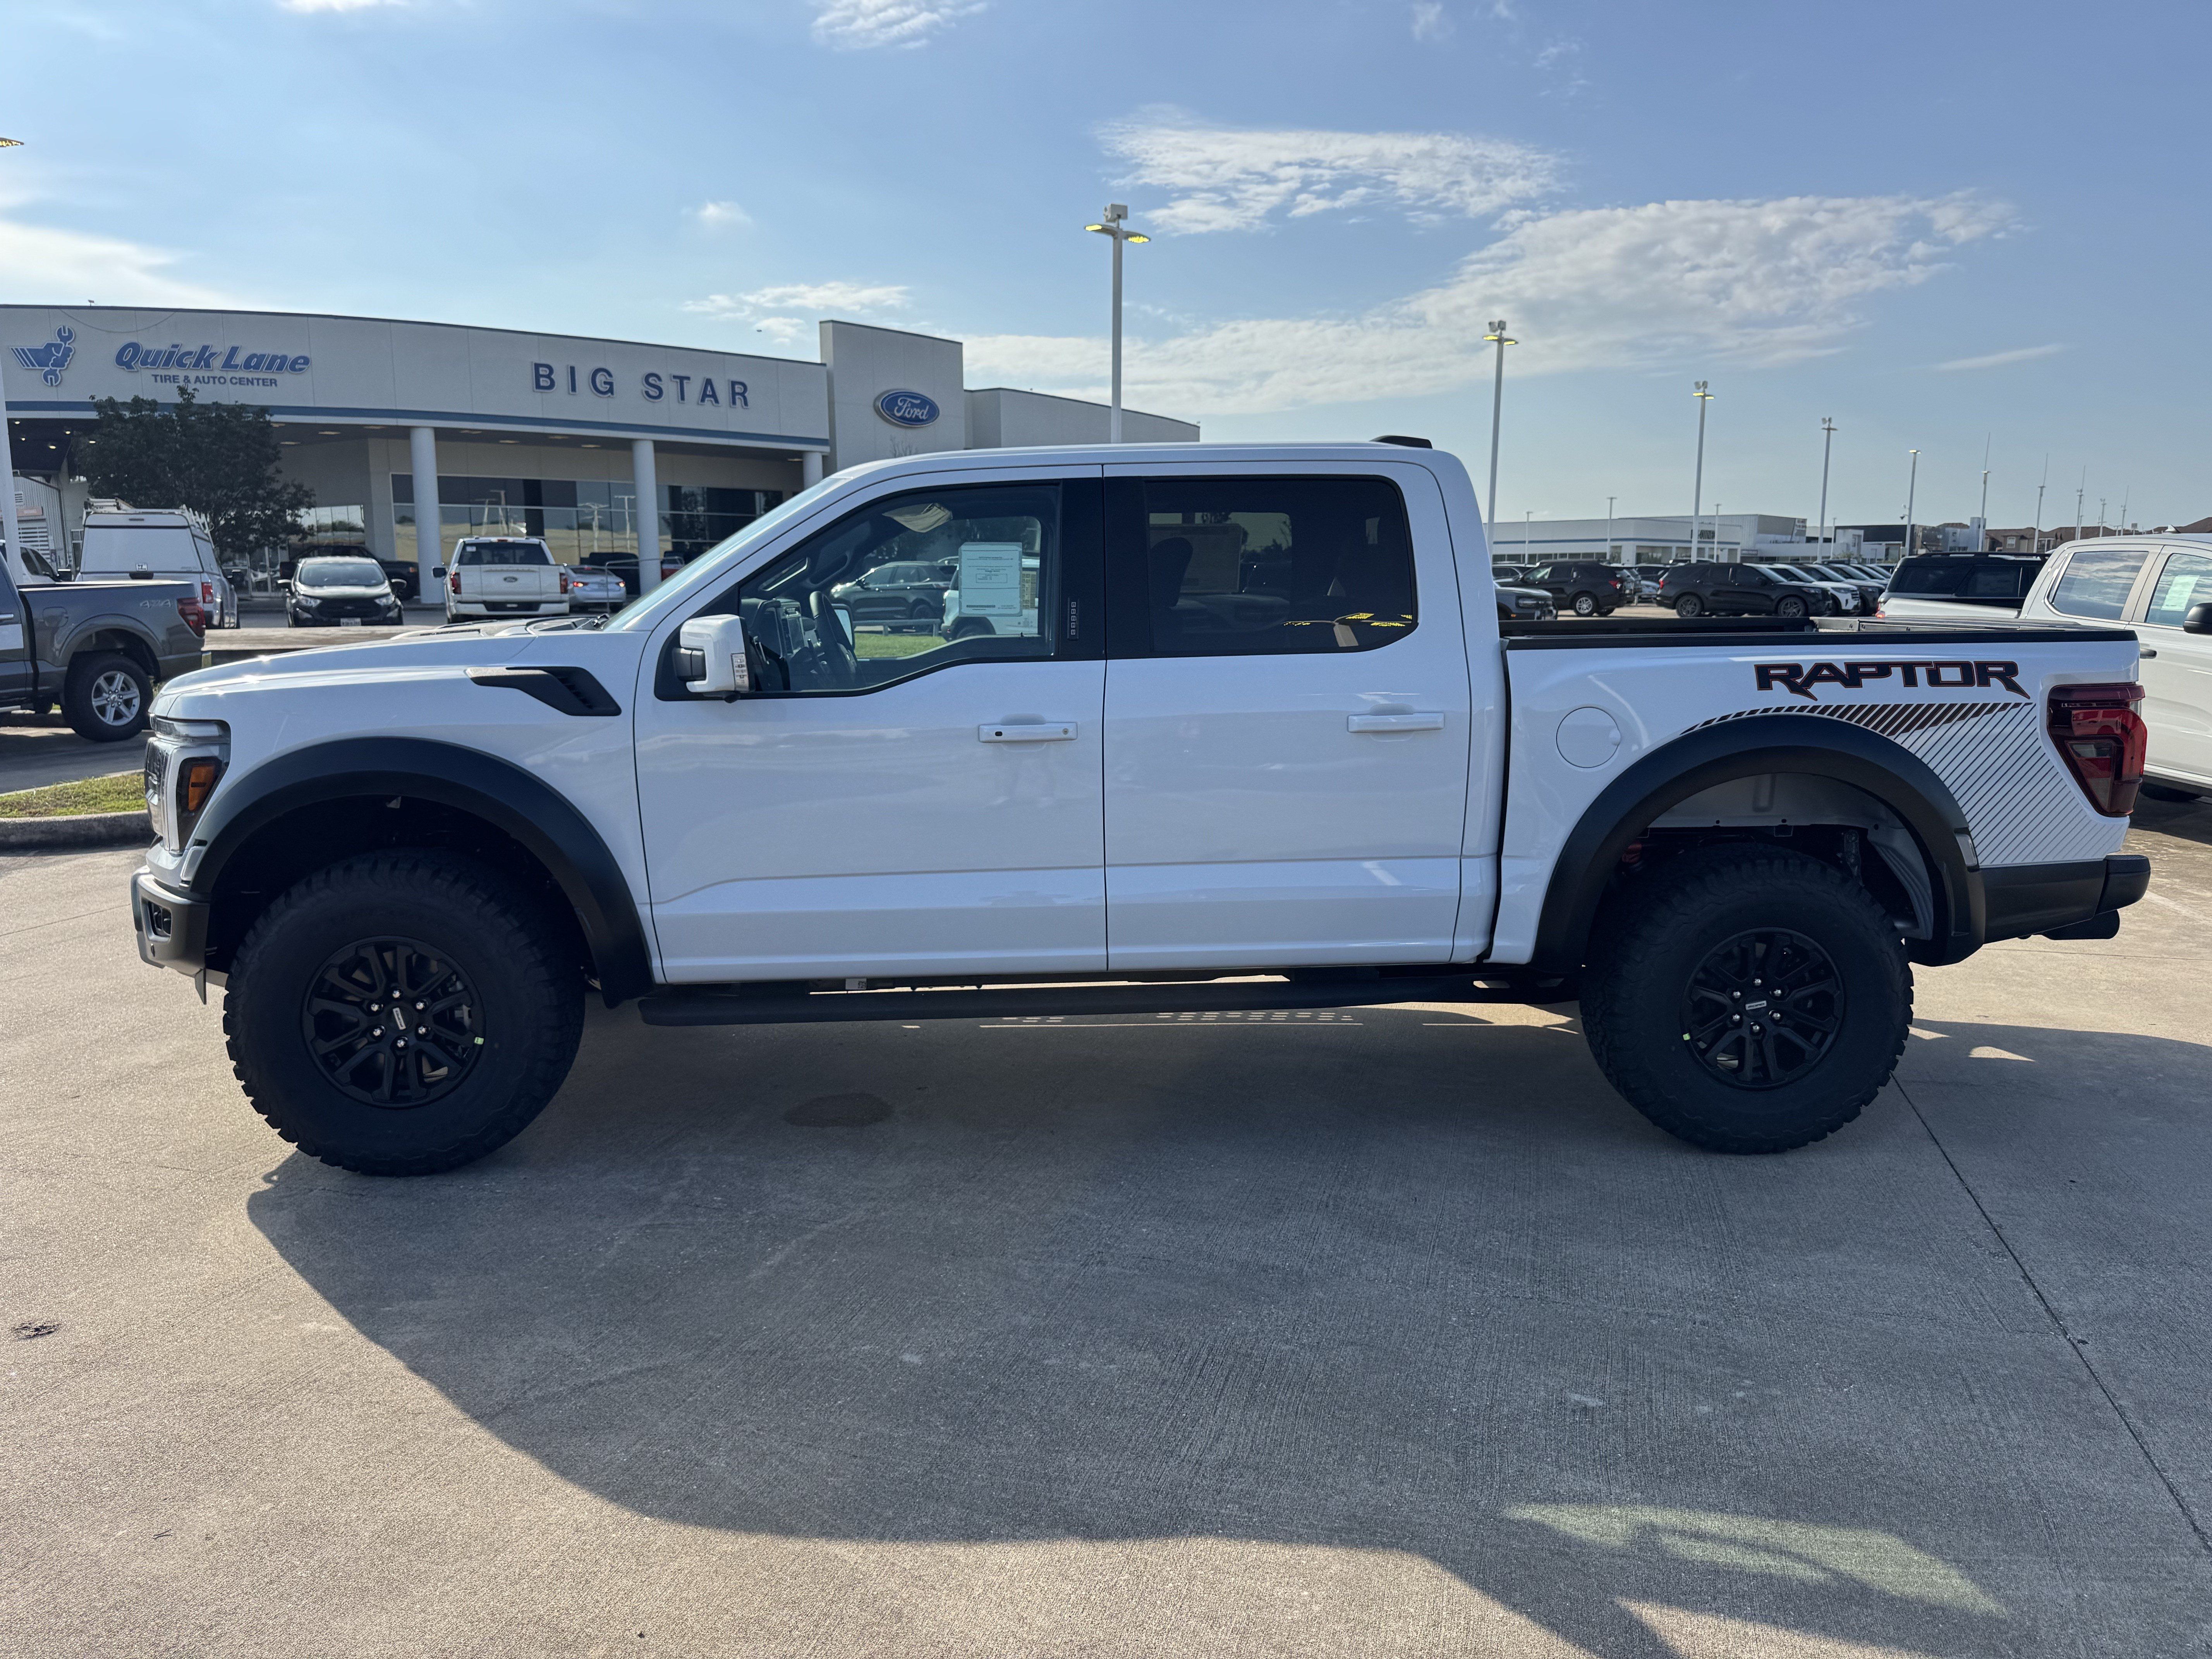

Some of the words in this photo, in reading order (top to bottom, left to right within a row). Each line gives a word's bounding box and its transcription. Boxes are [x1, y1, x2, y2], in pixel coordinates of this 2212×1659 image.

[115, 342, 222, 371] Quick
[220, 345, 311, 374] Lane
[151, 374, 180, 383] TIRE
[183, 375, 191, 383] &
[194, 375, 227, 385] AUTO
[229, 376, 278, 387] CENTER
[532, 362, 615, 397] BIG
[643, 372, 749, 409] STAR
[894, 397, 930, 420] Ford
[1754, 661, 2031, 701] RAPTOR
